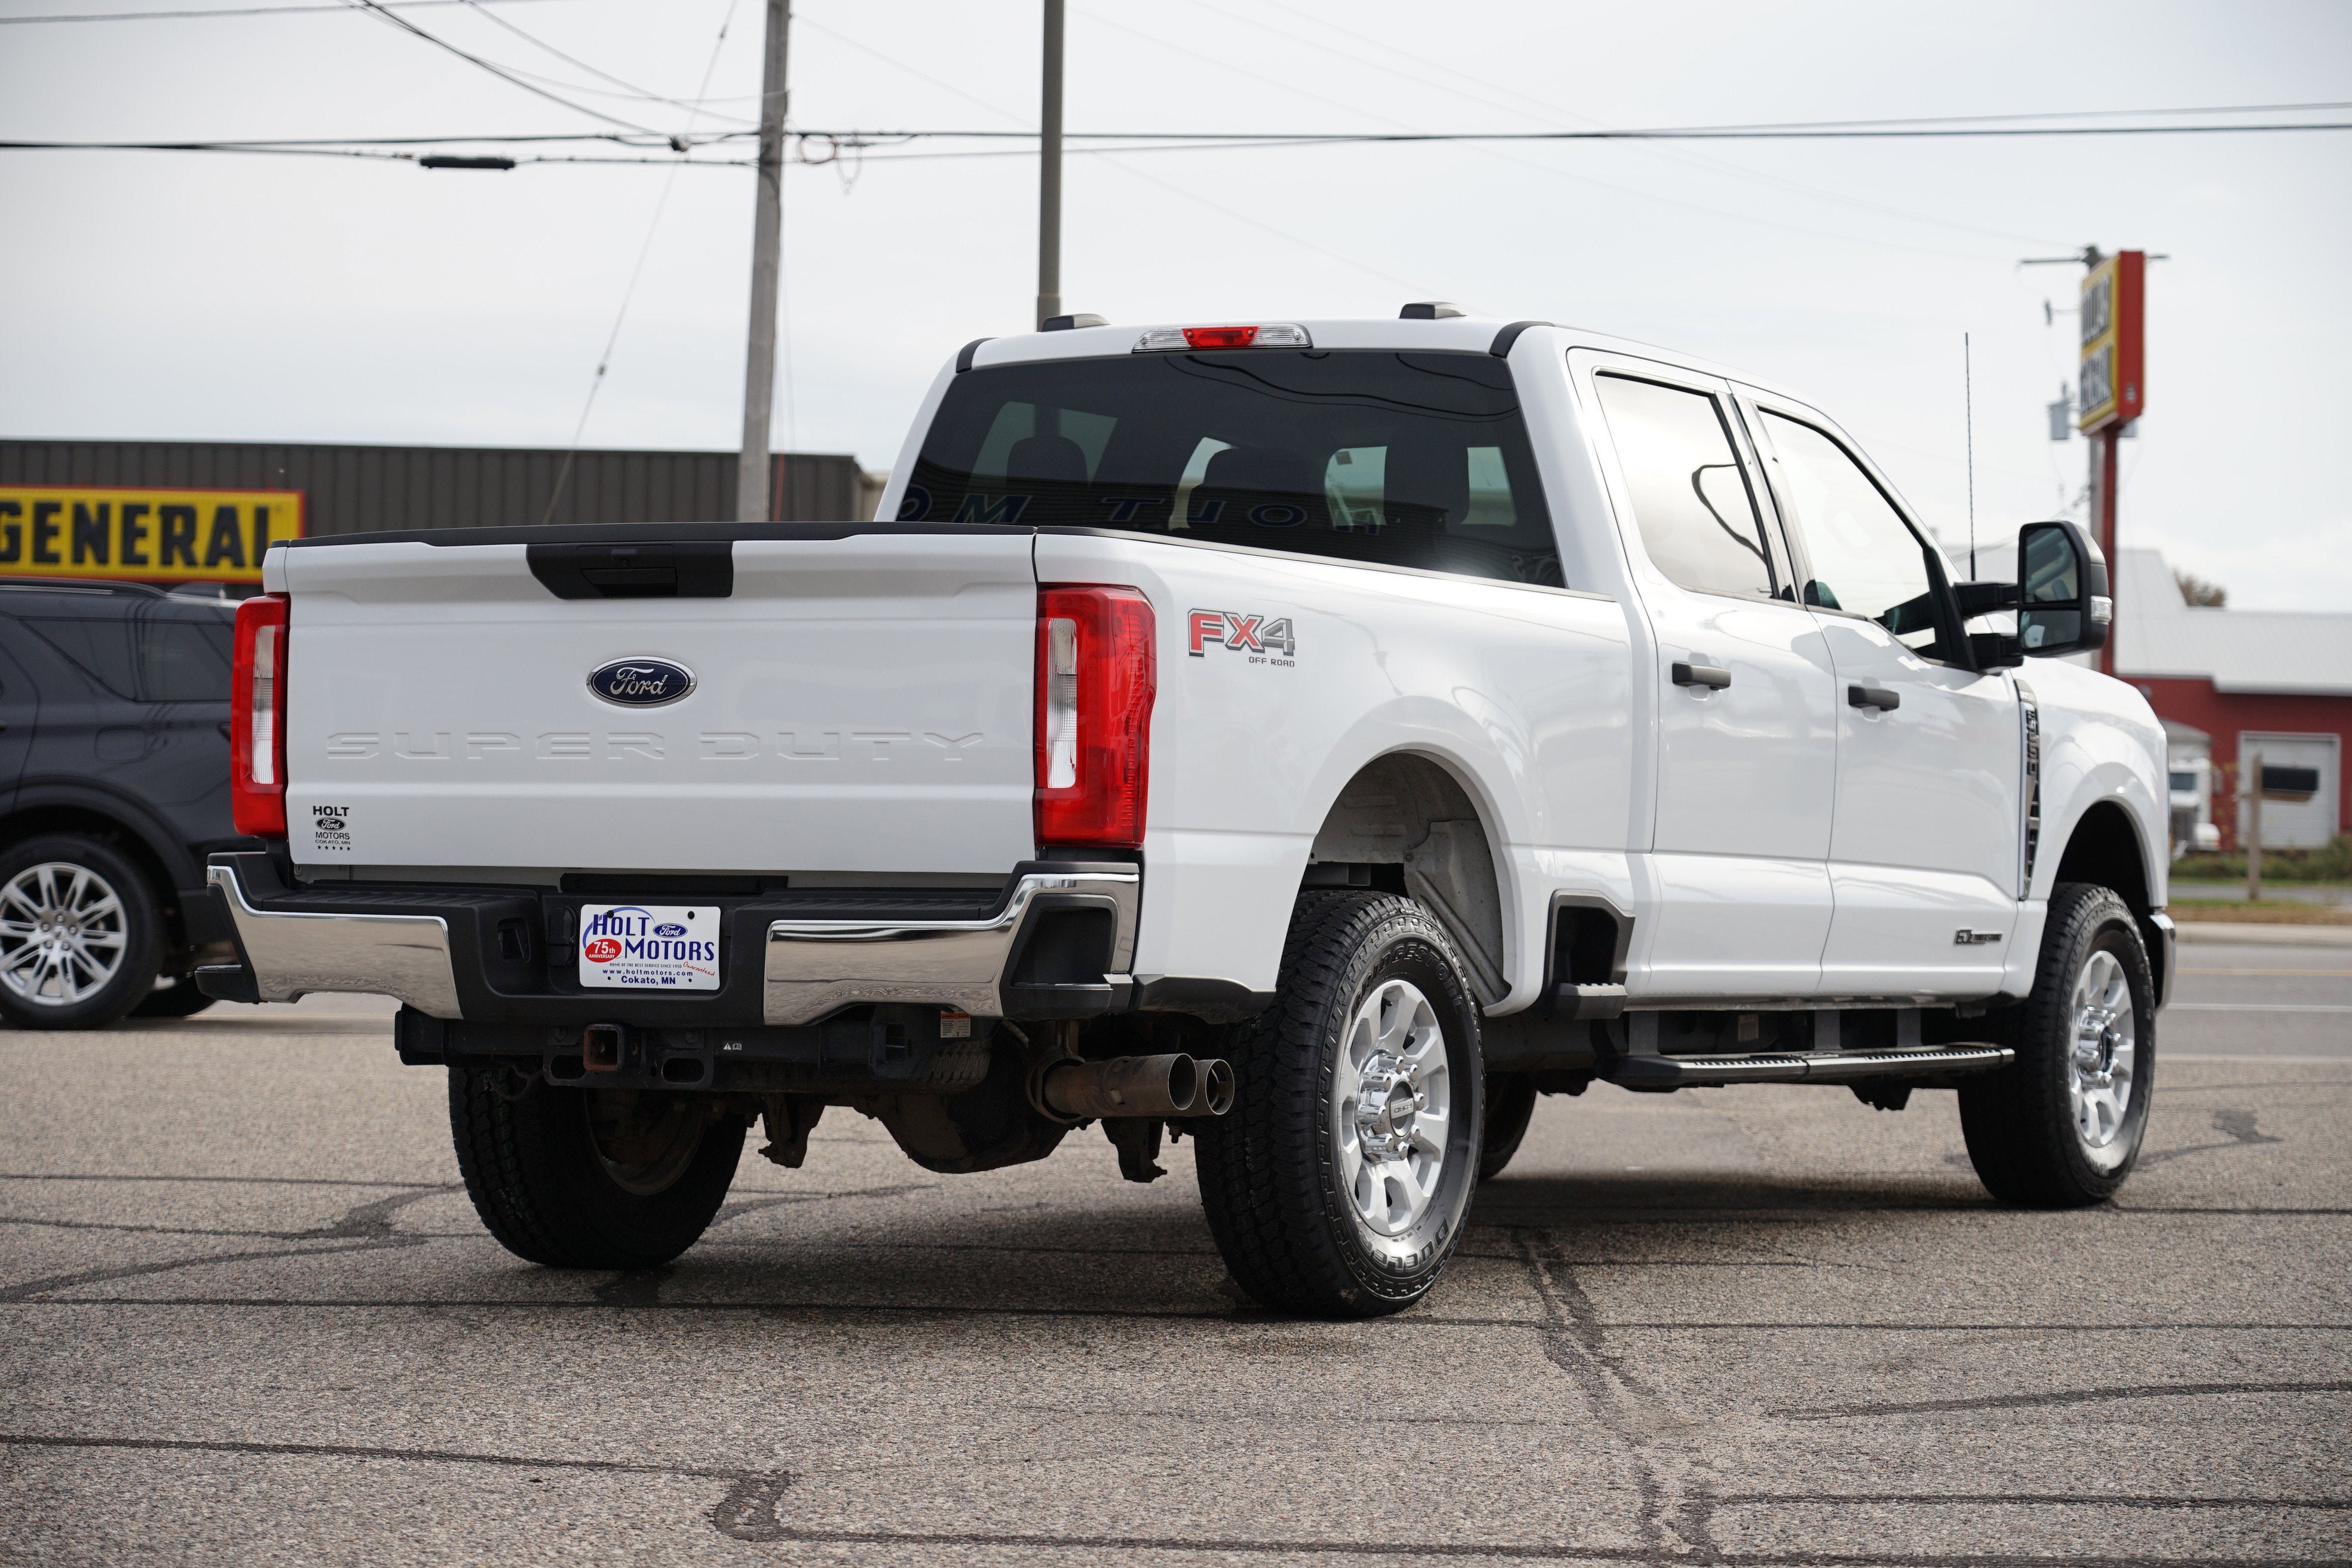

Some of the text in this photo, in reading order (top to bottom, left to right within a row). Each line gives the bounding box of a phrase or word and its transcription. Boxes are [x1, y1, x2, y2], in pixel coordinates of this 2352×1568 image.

[1188, 608, 1295, 657] FX4
[1249, 656, 1295, 667] OFF ROAD
[610, 667, 668, 695] Ford
[327, 731, 984, 761] SUPER DUTY
[313, 806, 350, 816] HOLT
[321, 819, 340, 829] Ford
[592, 914, 650, 936] HOLT
[659, 925, 681, 936] Ford
[594, 942, 615, 954] 75th
[625, 938, 715, 961] MOTORS
[683, 961, 715, 976] Guaranteed
[621, 975, 676, 986] Cokato, MN
[1394, 1103, 1413, 1113] FORD
